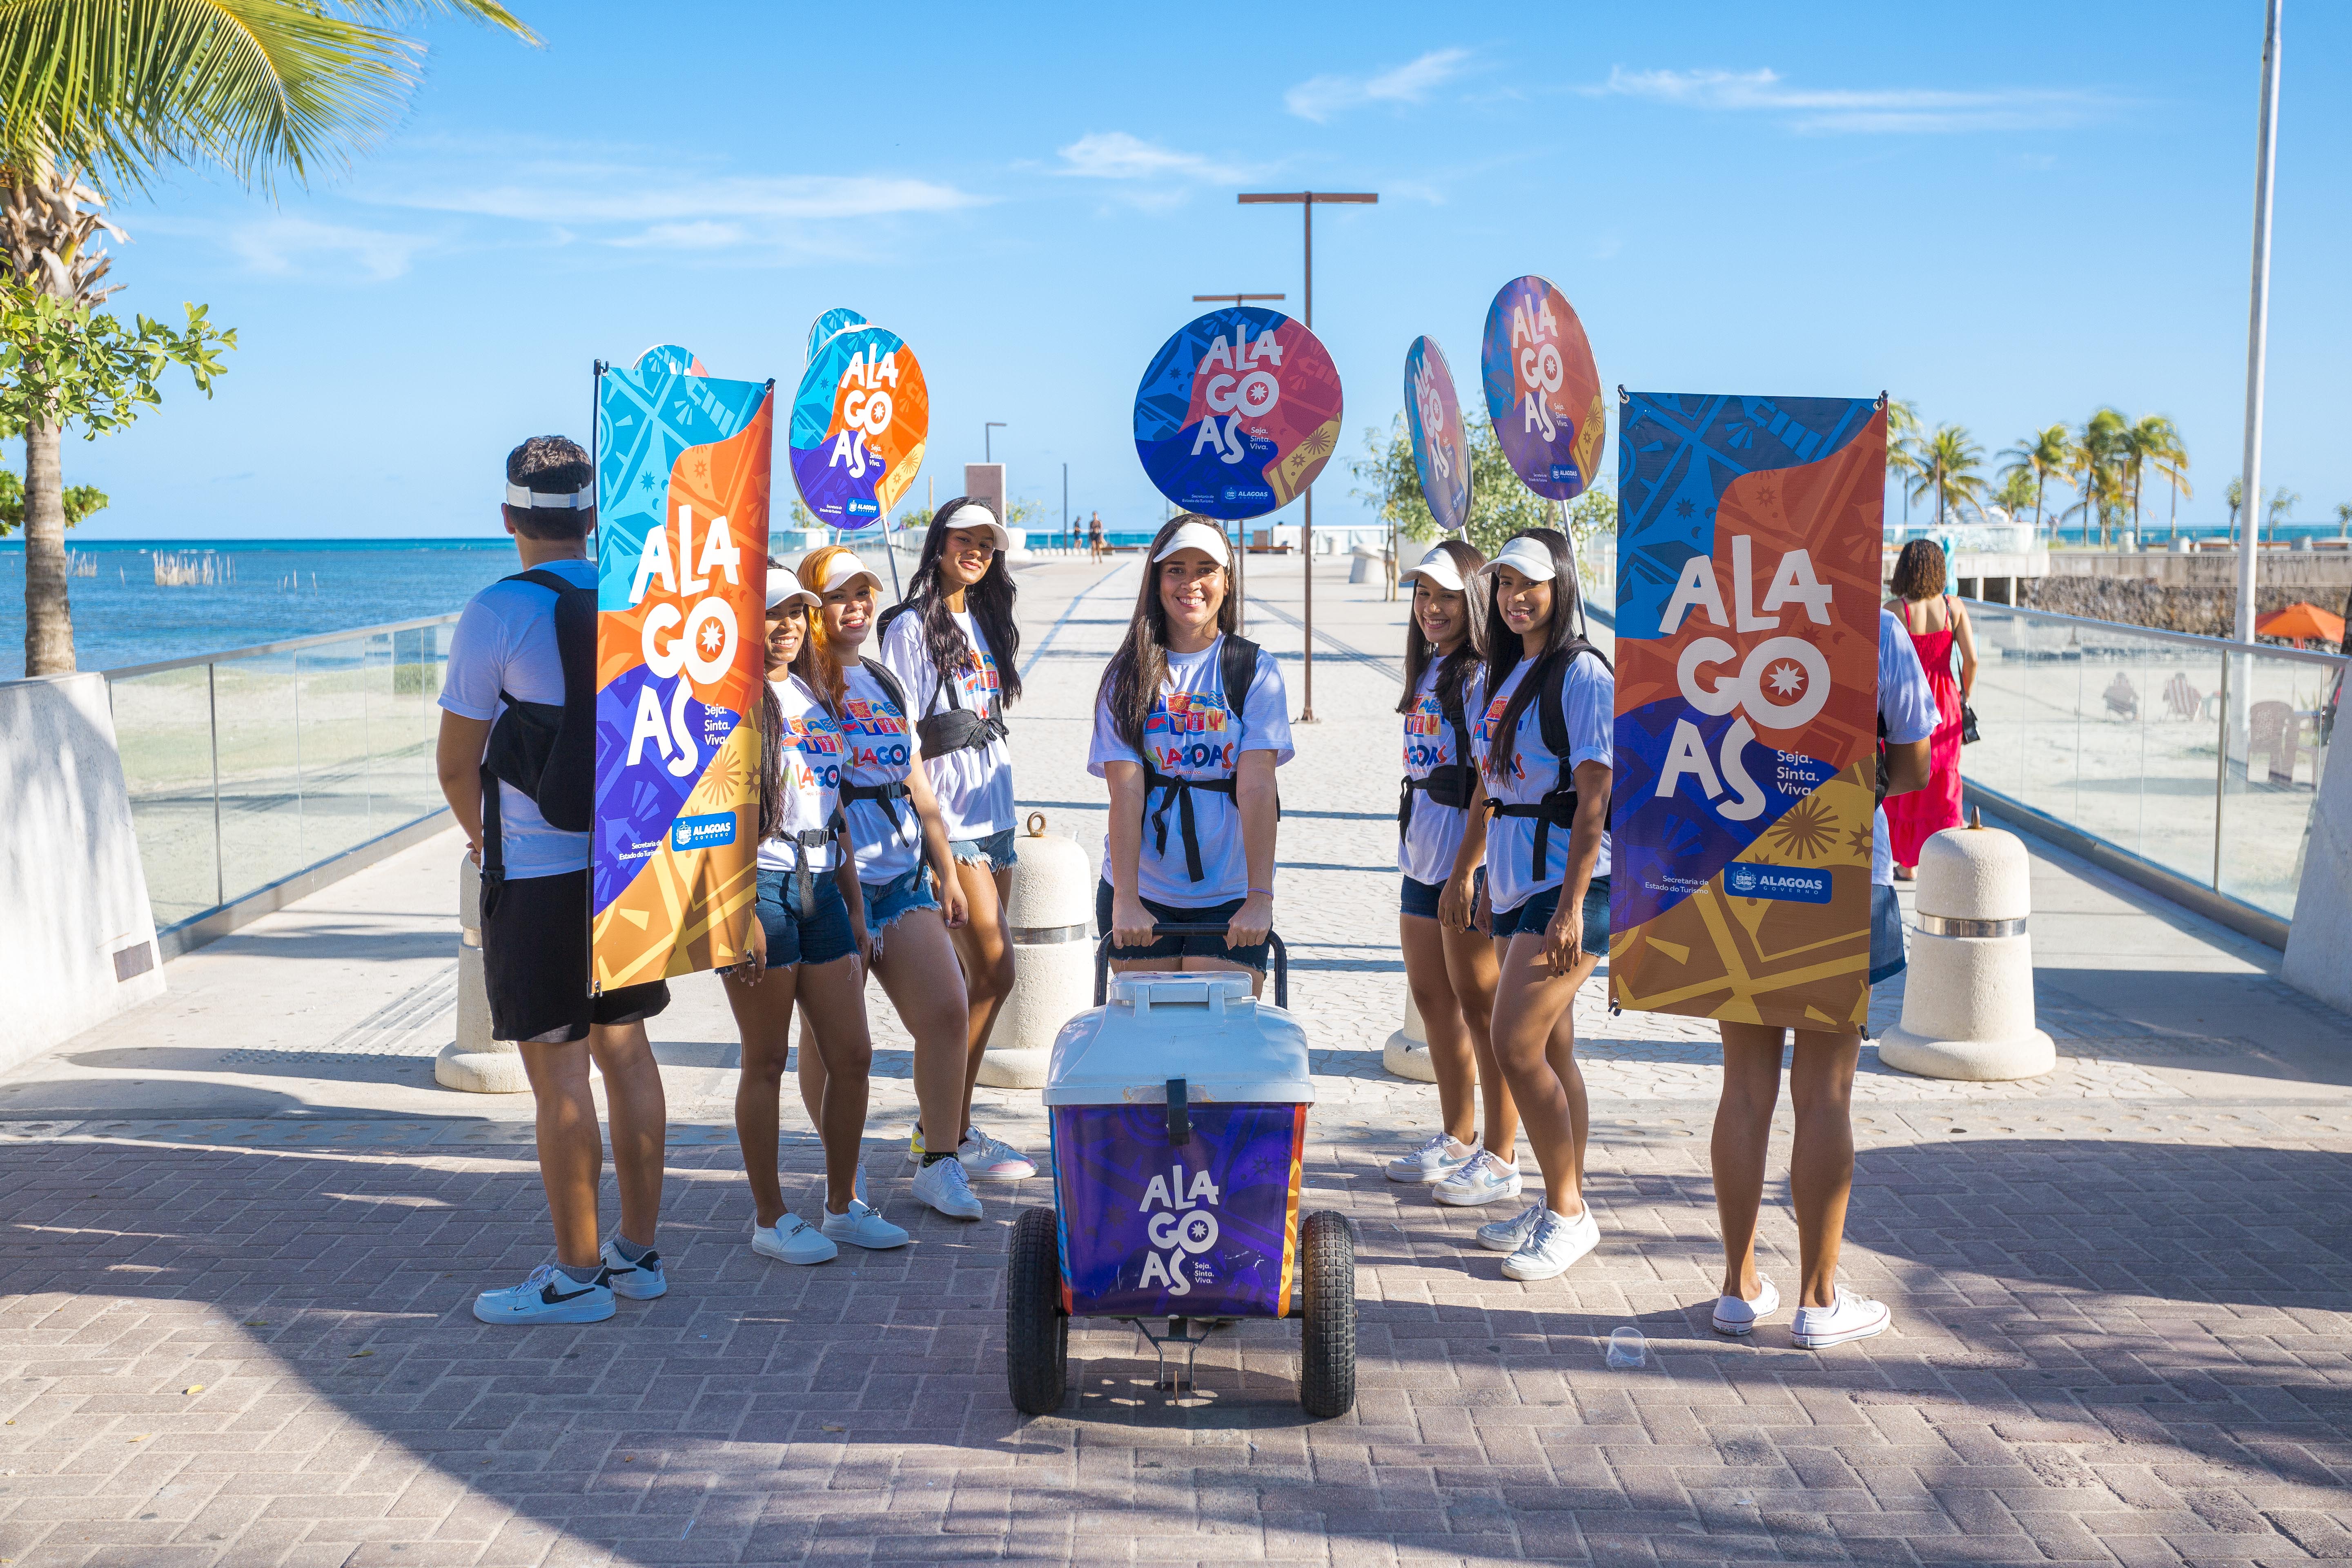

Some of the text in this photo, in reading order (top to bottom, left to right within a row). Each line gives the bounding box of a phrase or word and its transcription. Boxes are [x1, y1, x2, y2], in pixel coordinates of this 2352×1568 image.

[1513, 294, 1558, 349] ALA
[840, 343, 898, 389] ALA
[1198, 324, 1283, 375] ALA
[1521, 343, 1563, 393] GO
[844, 390, 893, 435] GO
[1206, 371, 1279, 417] GO
[1423, 388, 1443, 438] GO
[1525, 387, 1556, 442] AS
[829, 428, 866, 478] AS
[1191, 410, 1244, 464] AS
[1251, 427, 1268, 435] Seja.
[1431, 430, 1449, 482] AS
[628, 505, 740, 604] ALA
[1658, 535, 1832, 635] ALA
[641, 597, 738, 685] GO
[1677, 636, 1831, 730] GO
[626, 674, 699, 777] AS
[704, 719, 731, 731] Sinta.
[705, 704, 727, 718] Seja.
[1655, 715, 1766, 821] AS
[1777, 750, 1813, 766] Seja.
[1777, 766, 1819, 781] Sinta.
[1777, 782, 1815, 796] Viva.
[632, 840, 656, 849] Secretaria
[693, 822, 731, 836] ALAGOAS
[695, 832, 728, 840] GOVERNO
[619, 851, 636, 860] Estado
[1645, 882, 1669, 891] Estado
[1663, 875, 1699, 885] Secretaria
[1760, 876, 1822, 890] ALAGOAS
[1764, 886, 1818, 895] GOVERNO
[1139, 1165, 1218, 1212] ALA
[1148, 1210, 1218, 1254] GO
[1138, 1247, 1190, 1296] AS
